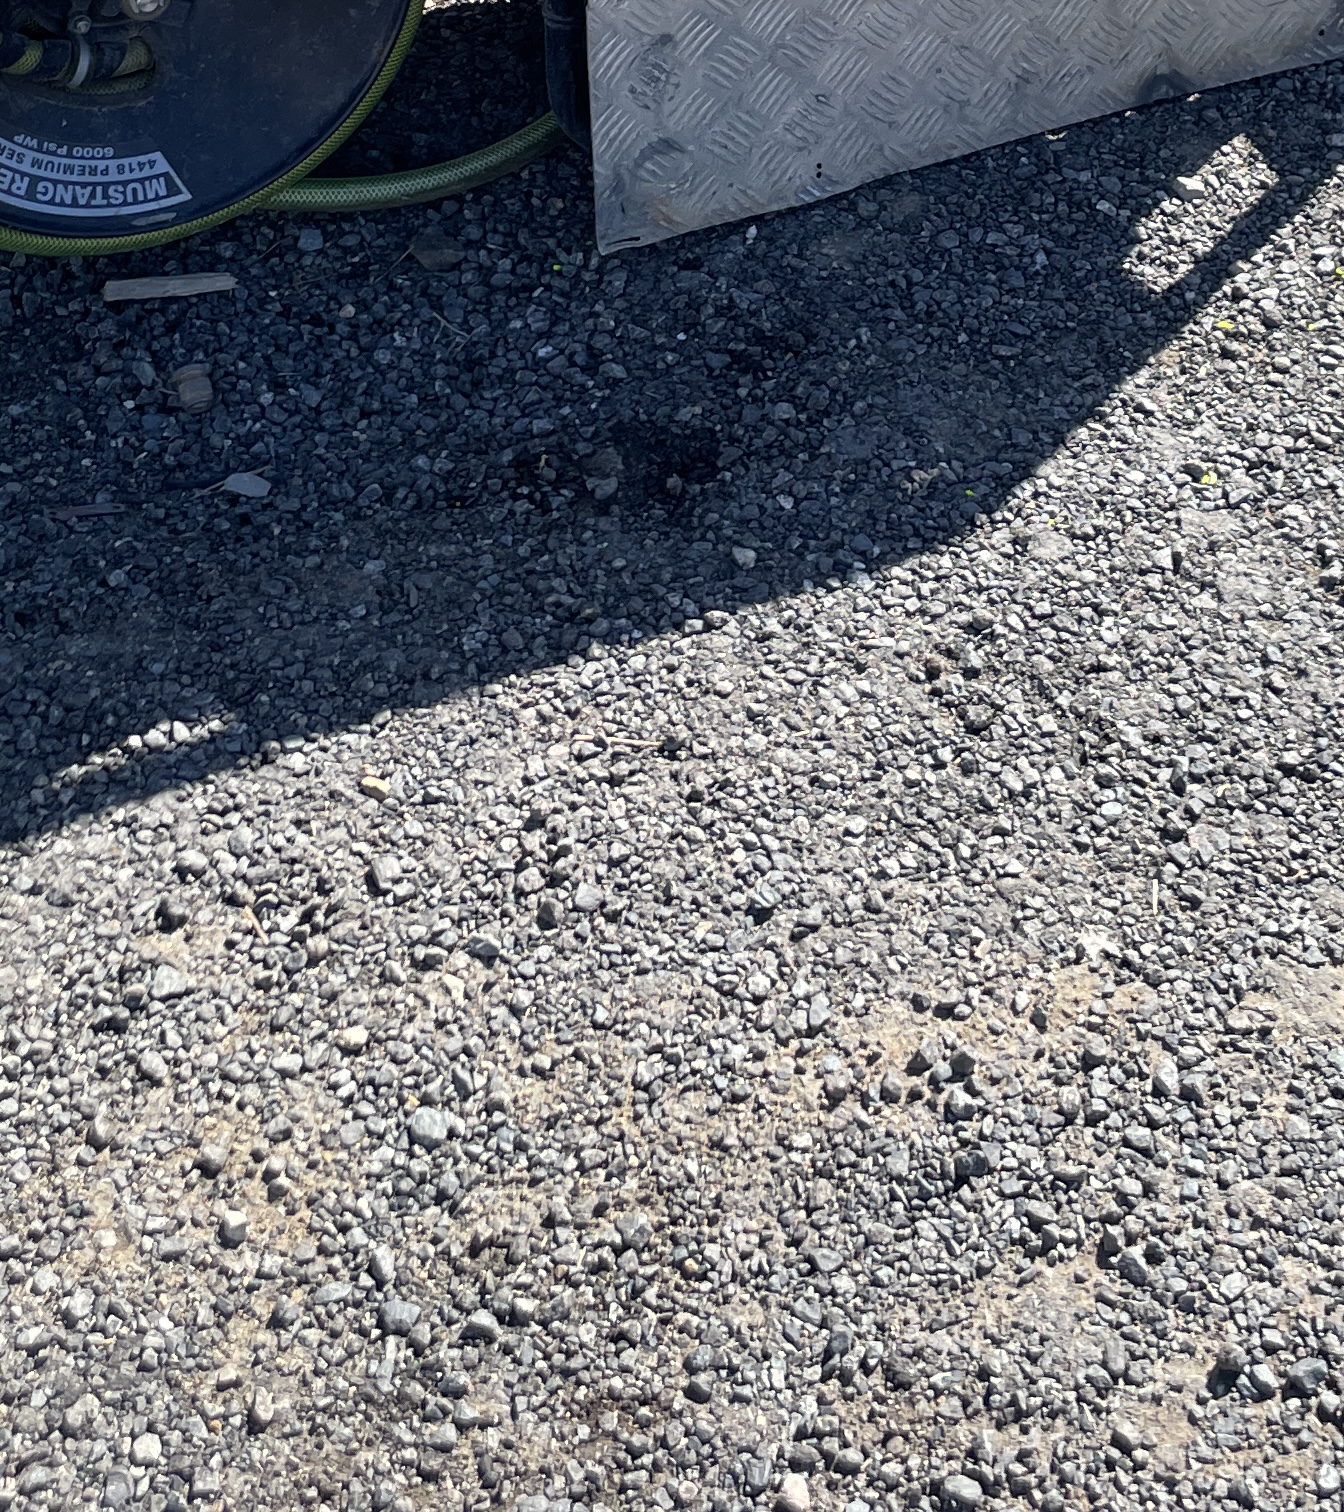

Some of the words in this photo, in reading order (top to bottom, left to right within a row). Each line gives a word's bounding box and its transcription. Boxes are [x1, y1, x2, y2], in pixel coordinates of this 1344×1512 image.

[12, 133, 39, 148] WP
[72, 145, 115, 159] 6000
[30, 156, 110, 176] PREMIUM
[115, 158, 157, 176] 4418
[36, 176, 168, 206] MUSTANG
